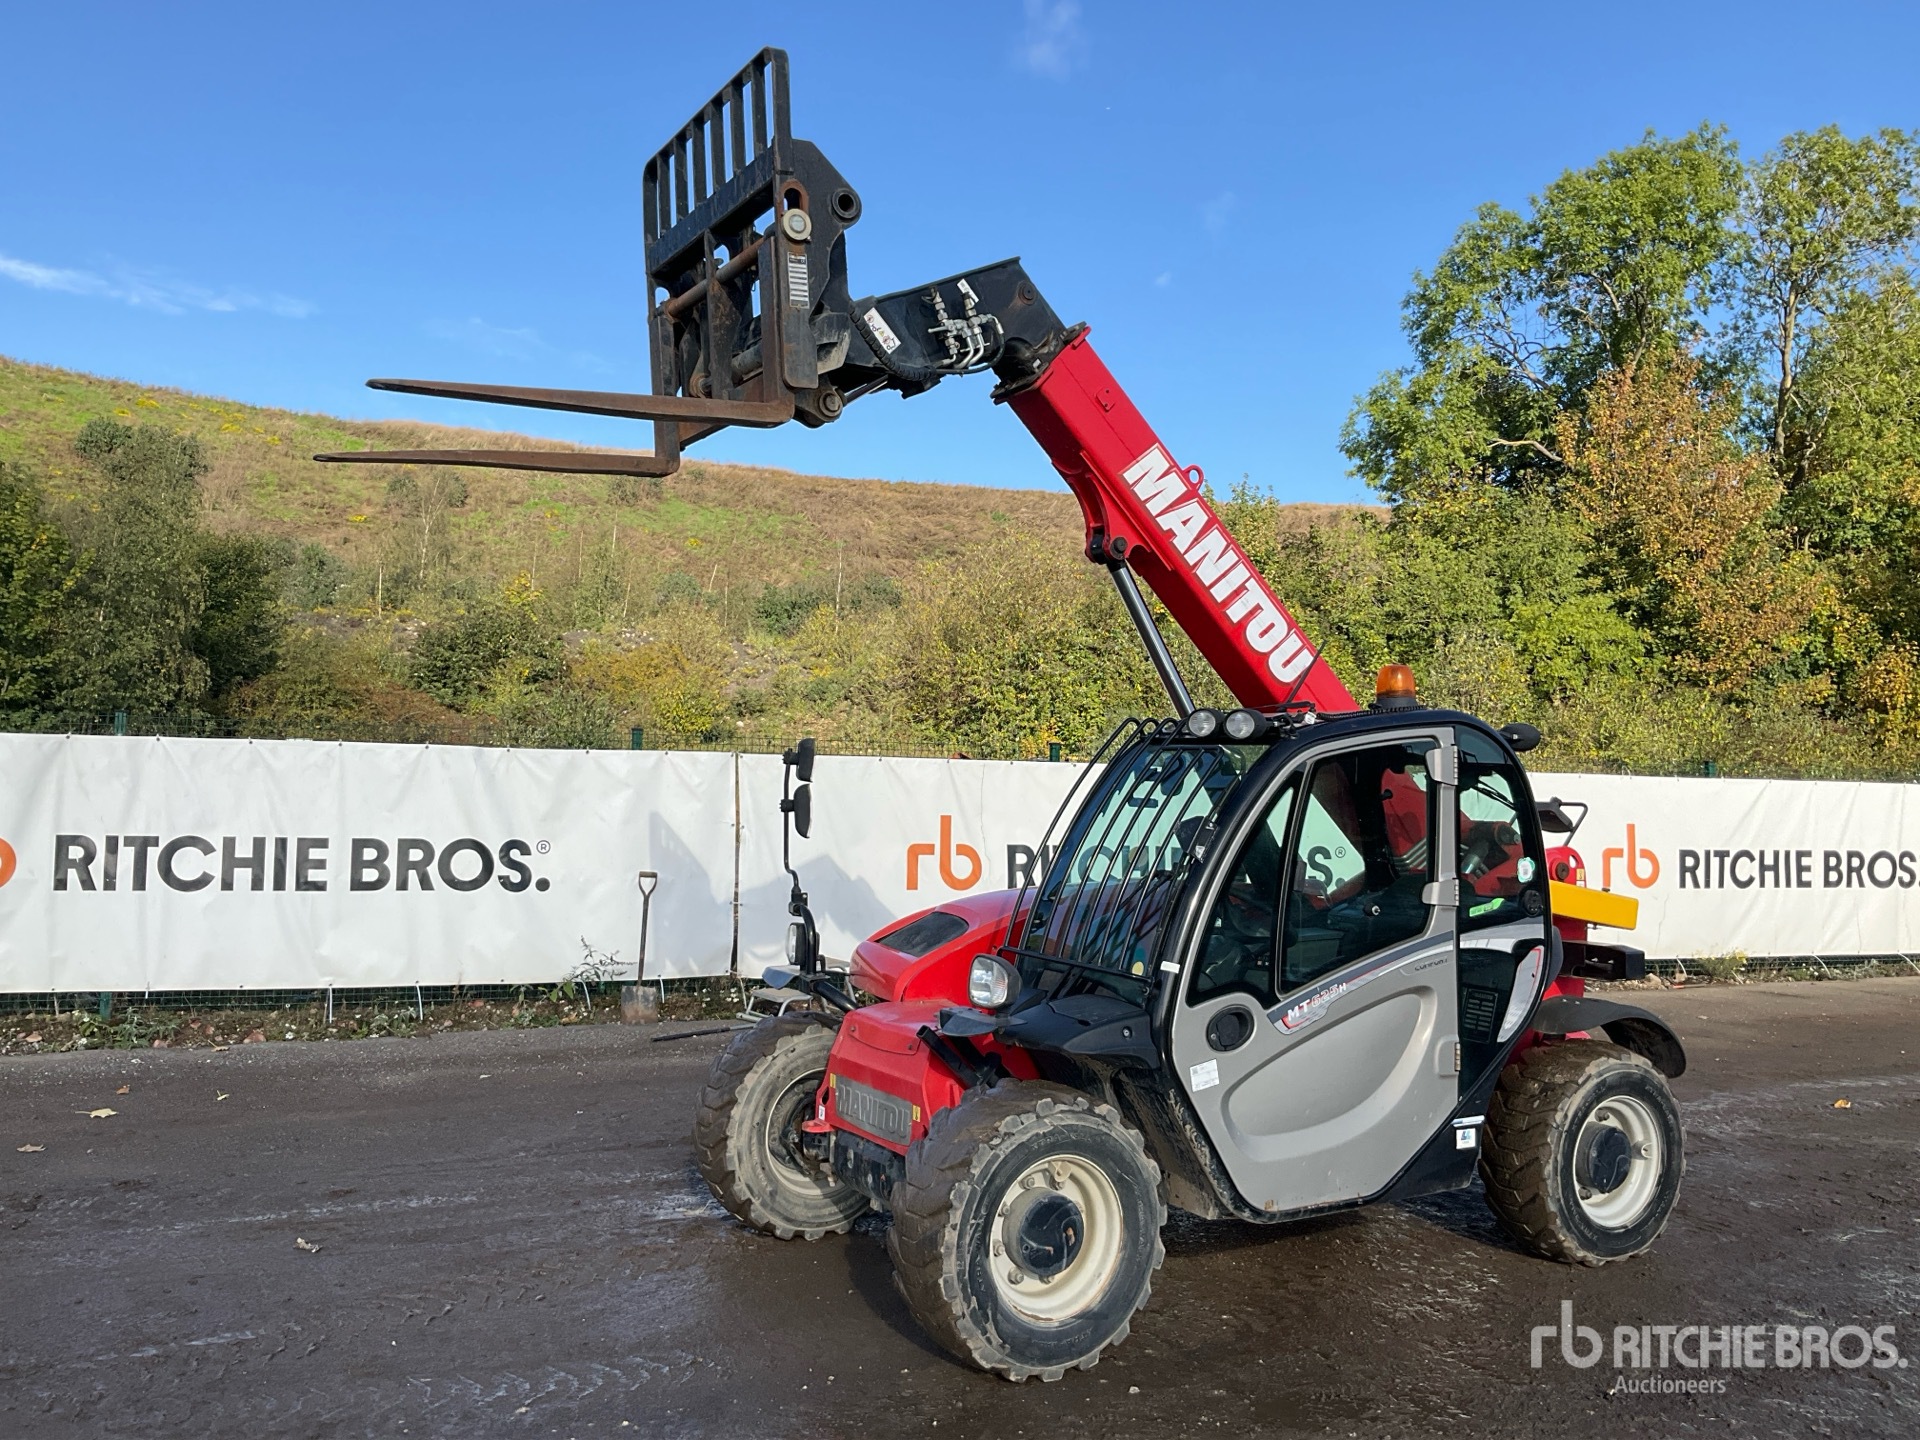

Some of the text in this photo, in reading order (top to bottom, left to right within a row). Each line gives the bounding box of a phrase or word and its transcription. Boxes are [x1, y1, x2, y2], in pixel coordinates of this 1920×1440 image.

[1122, 447, 1314, 684] MANITOU
[53, 834, 330, 892] RITCHIE
[1679, 849, 1812, 889] RITCHIE
[1823, 849, 1920, 889] BROS
[838, 1084, 911, 1138] MANITOU
